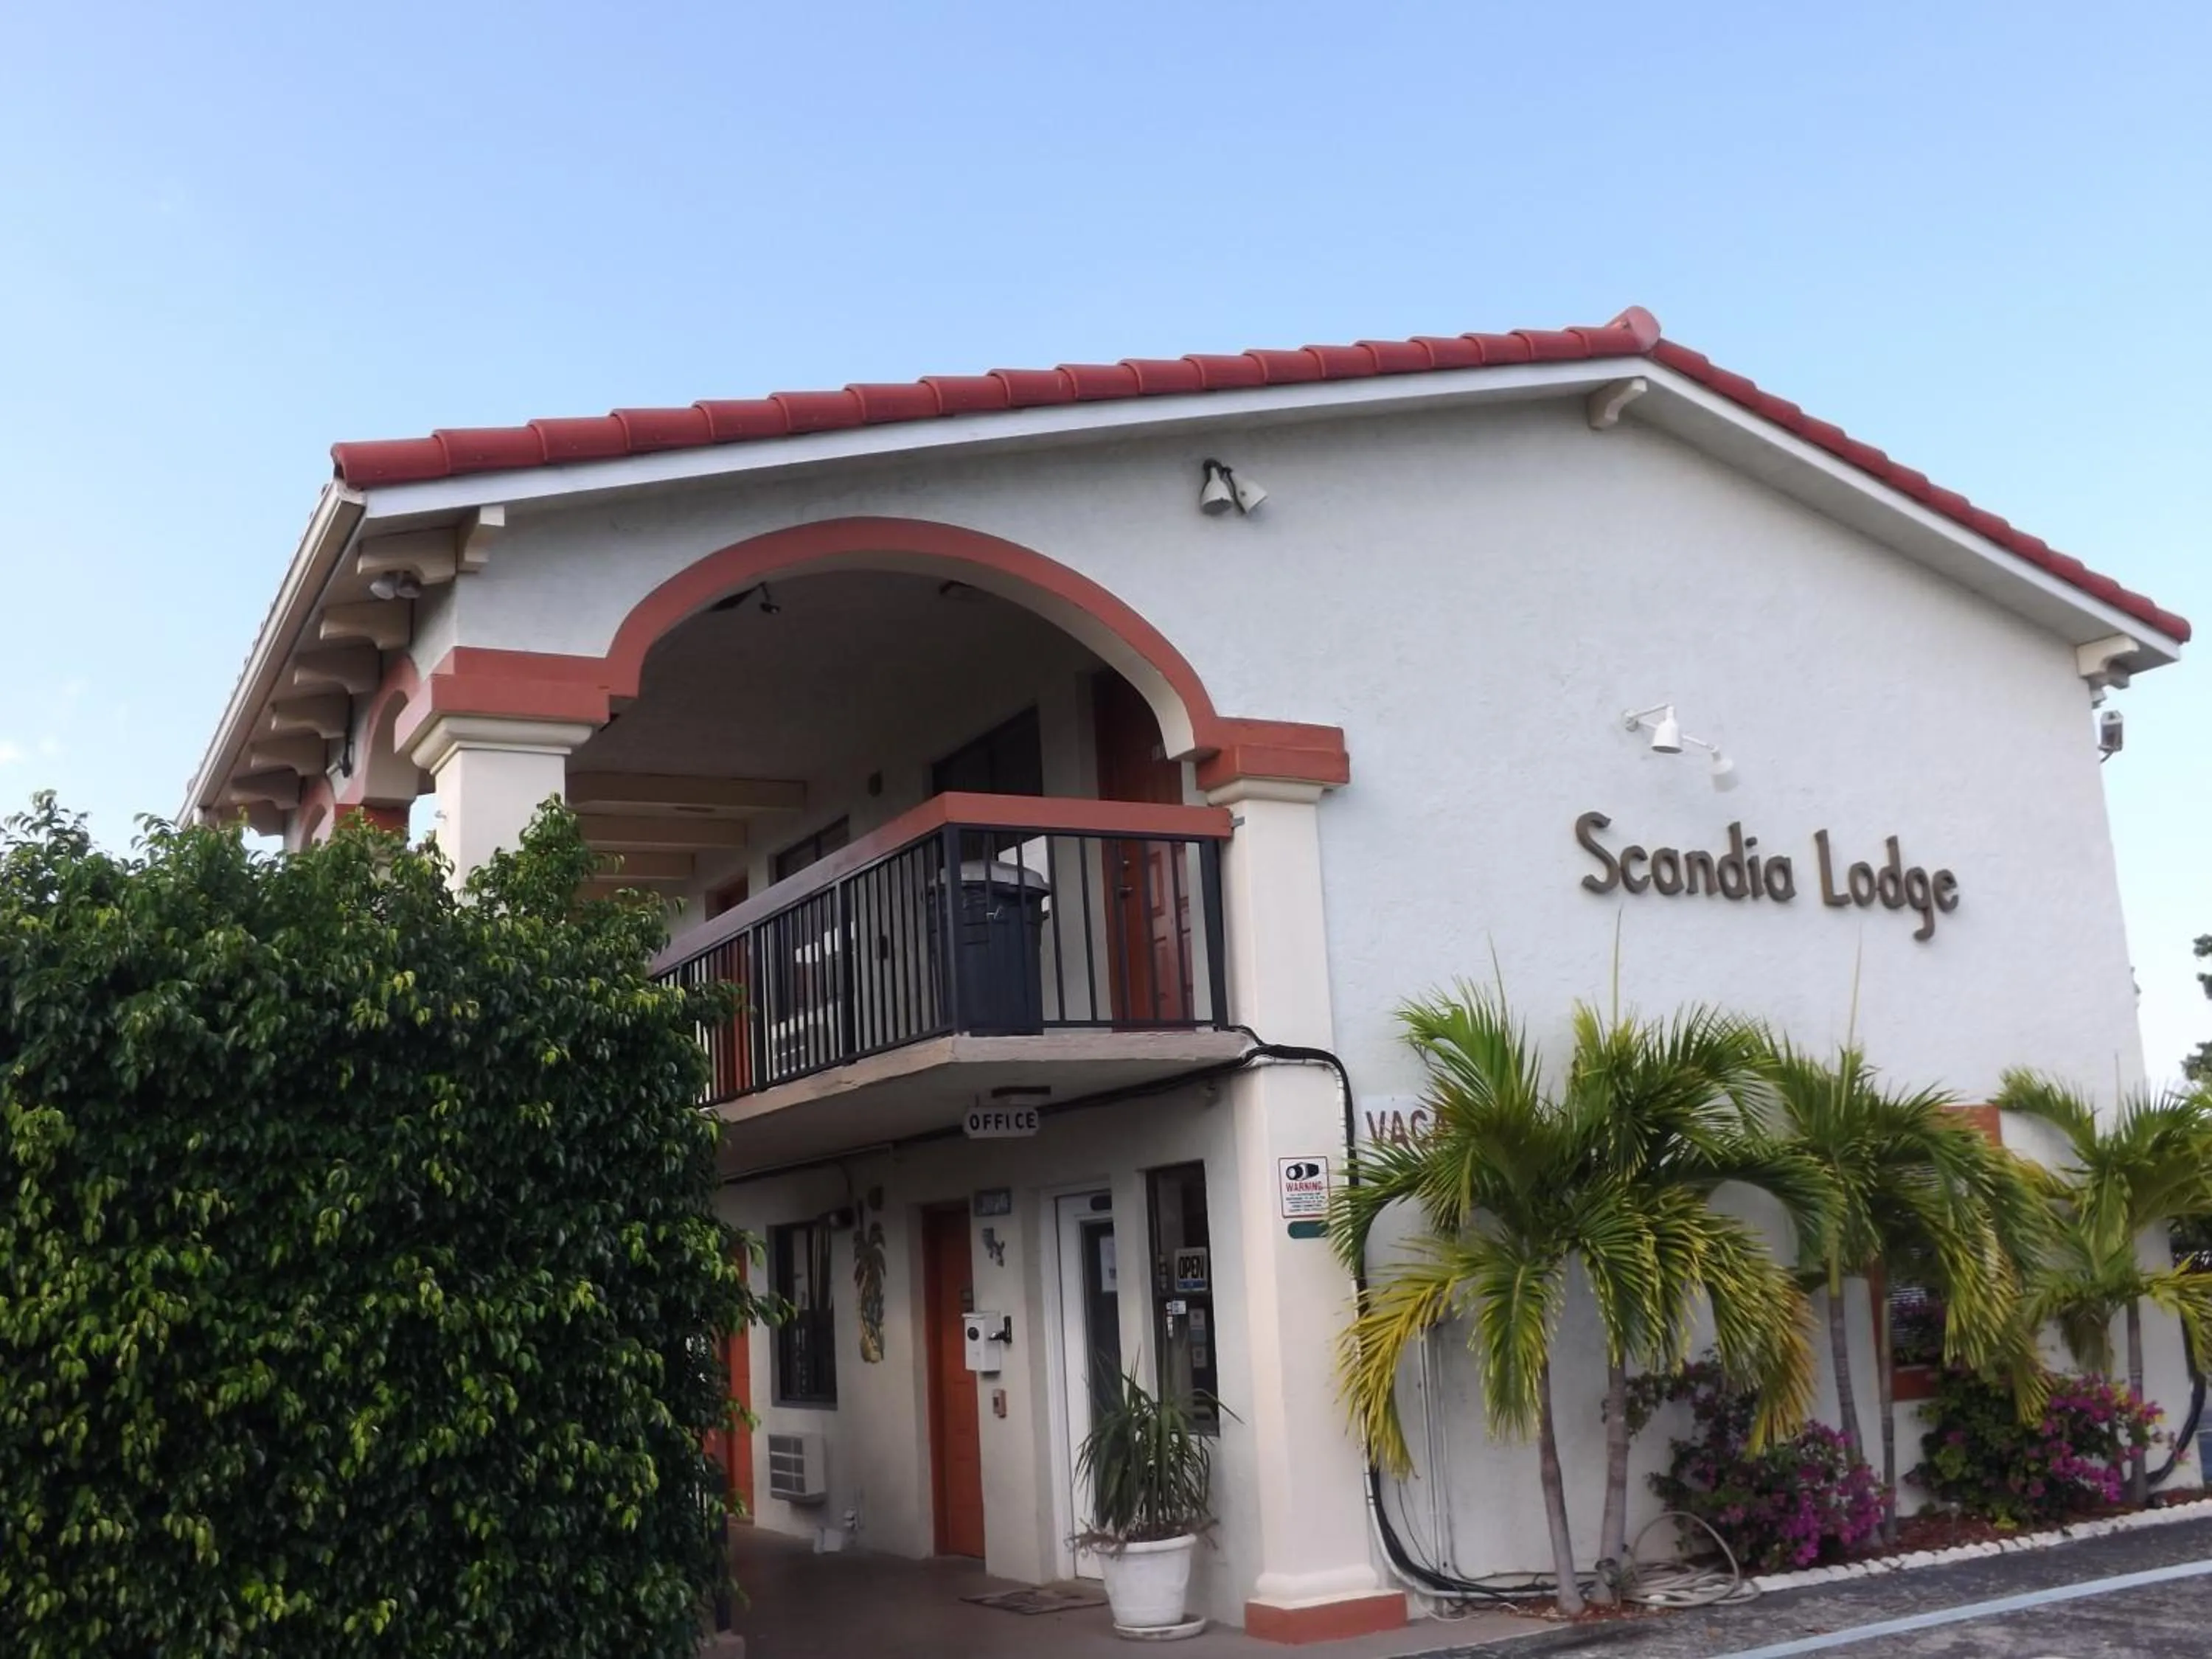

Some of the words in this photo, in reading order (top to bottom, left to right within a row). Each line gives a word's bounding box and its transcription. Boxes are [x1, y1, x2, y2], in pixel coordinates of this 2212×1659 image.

[1575, 811, 1797, 901] Scandia
[1815, 830, 1959, 941] Lodge
[969, 1112, 1037, 1131] OFFICE
[1286, 1181, 1322, 1192] WARNING
[1178, 1255, 1204, 1279] OPEN
